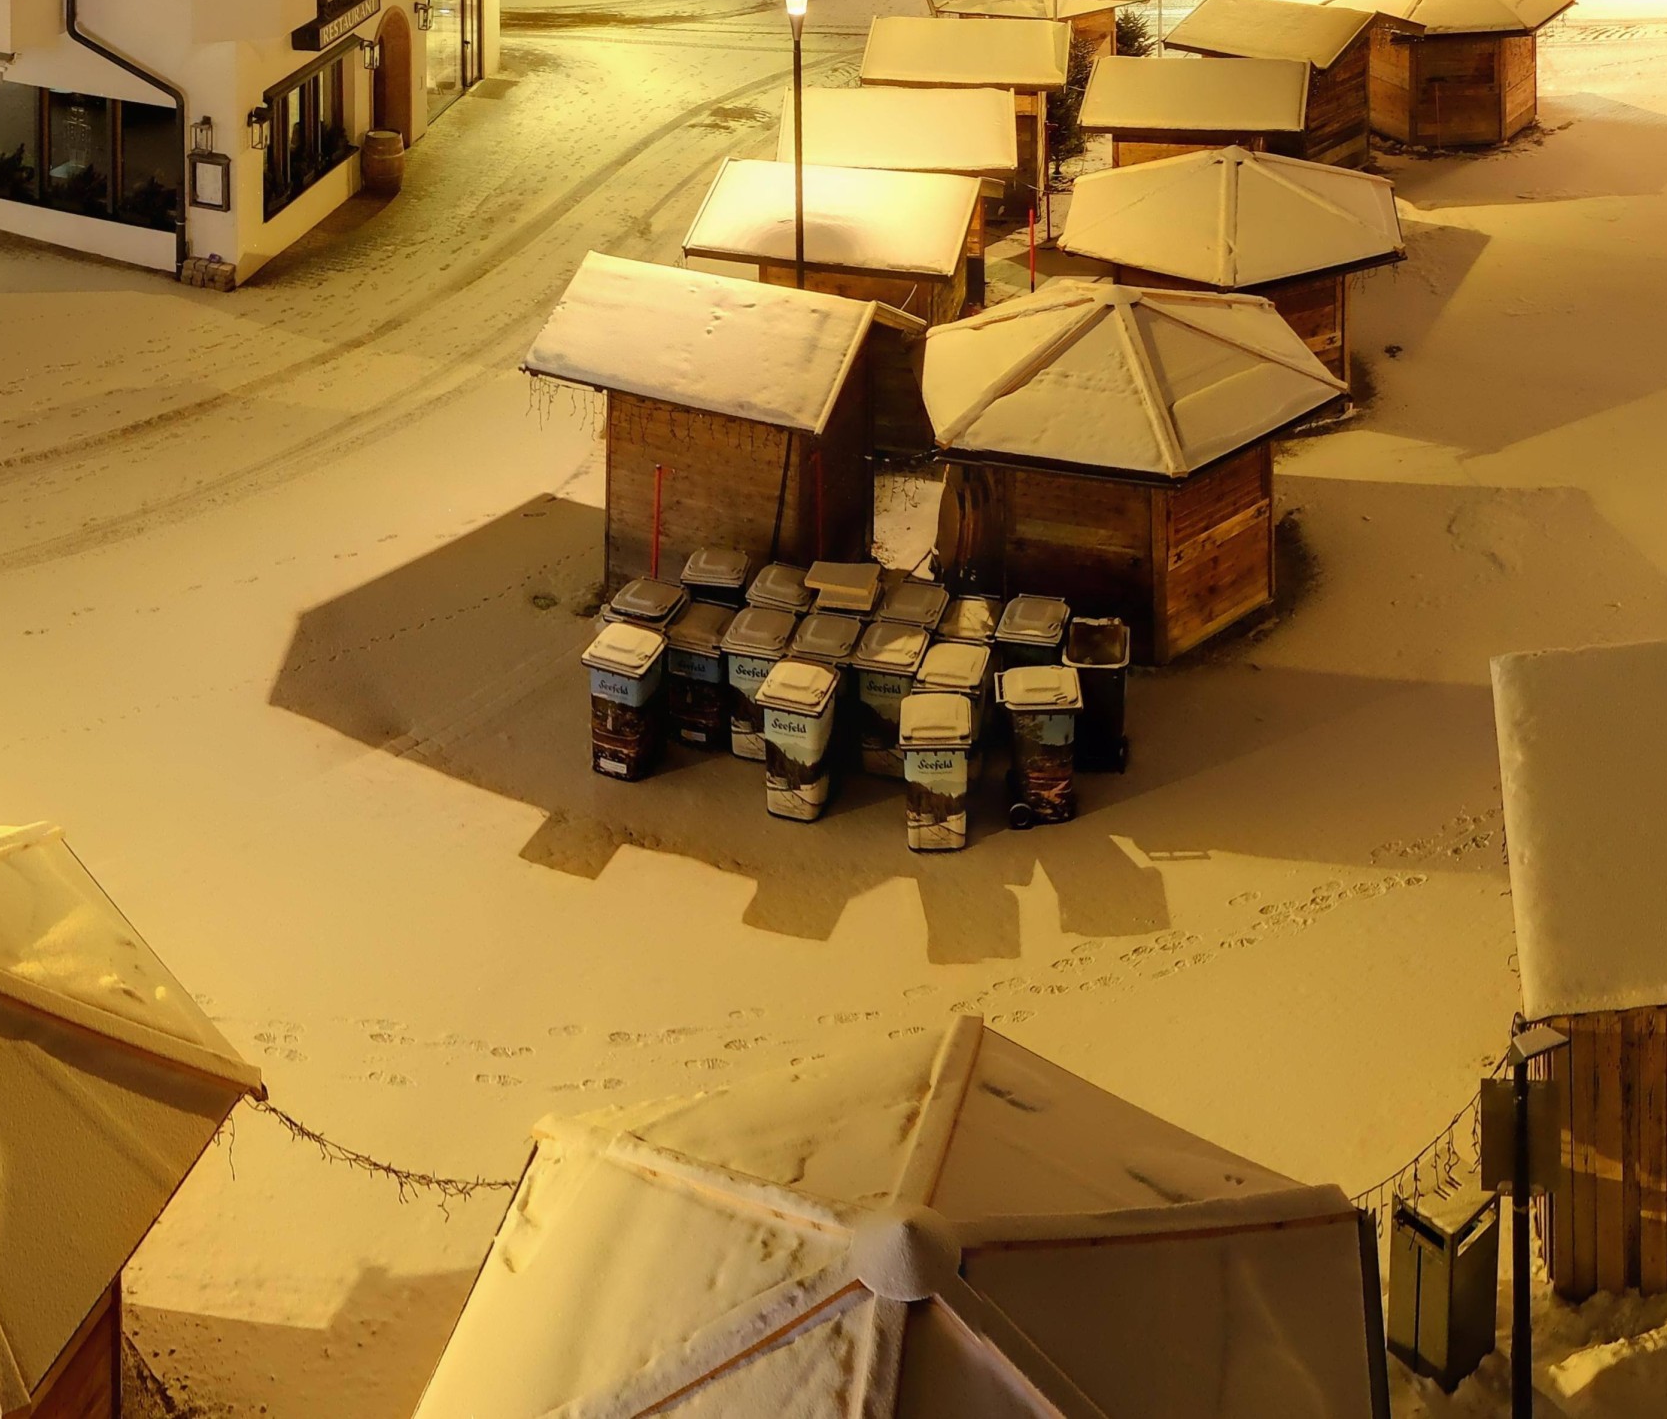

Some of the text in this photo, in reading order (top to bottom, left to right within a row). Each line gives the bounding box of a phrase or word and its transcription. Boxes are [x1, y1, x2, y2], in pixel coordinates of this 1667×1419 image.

[736, 664, 769, 678] Seefeld
[598, 679, 629, 696] Seefeld
[866, 681, 902, 694] Seefeld
[771, 717, 807, 733] Seefeld
[917, 758, 953, 771] Seefeld
